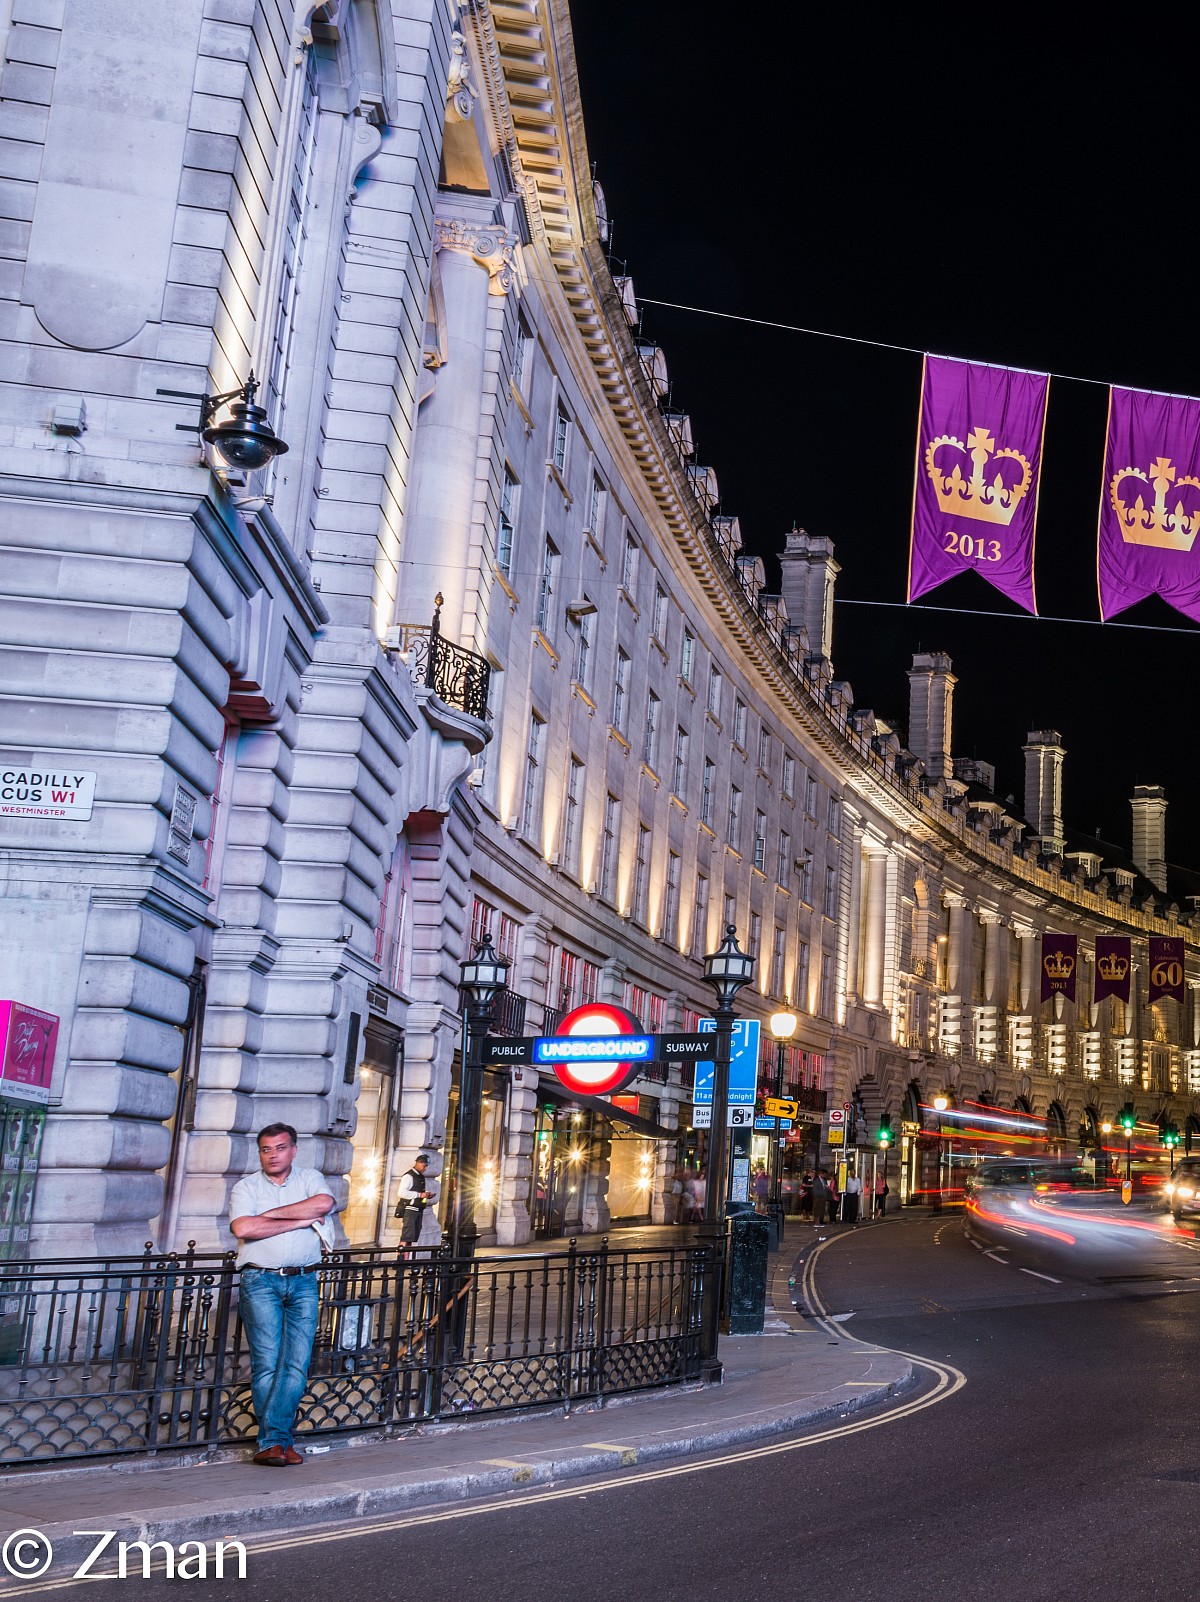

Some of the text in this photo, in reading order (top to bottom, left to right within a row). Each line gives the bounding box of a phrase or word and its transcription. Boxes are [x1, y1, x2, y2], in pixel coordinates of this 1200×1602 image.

[945, 531, 1002, 563] 2013
[0, 771, 85, 789] CADILLY
[51, 790, 76, 804] W1
[2, 806, 66, 816] WESTMINSTER
[1151, 961, 1183, 987] 60
[1050, 981, 1067, 989] 2013
[491, 1046, 525, 1056] PUBLIC
[541, 1041, 648, 1057] UNDERGROUND
[666, 1042, 710, 1053] SUBWAY
